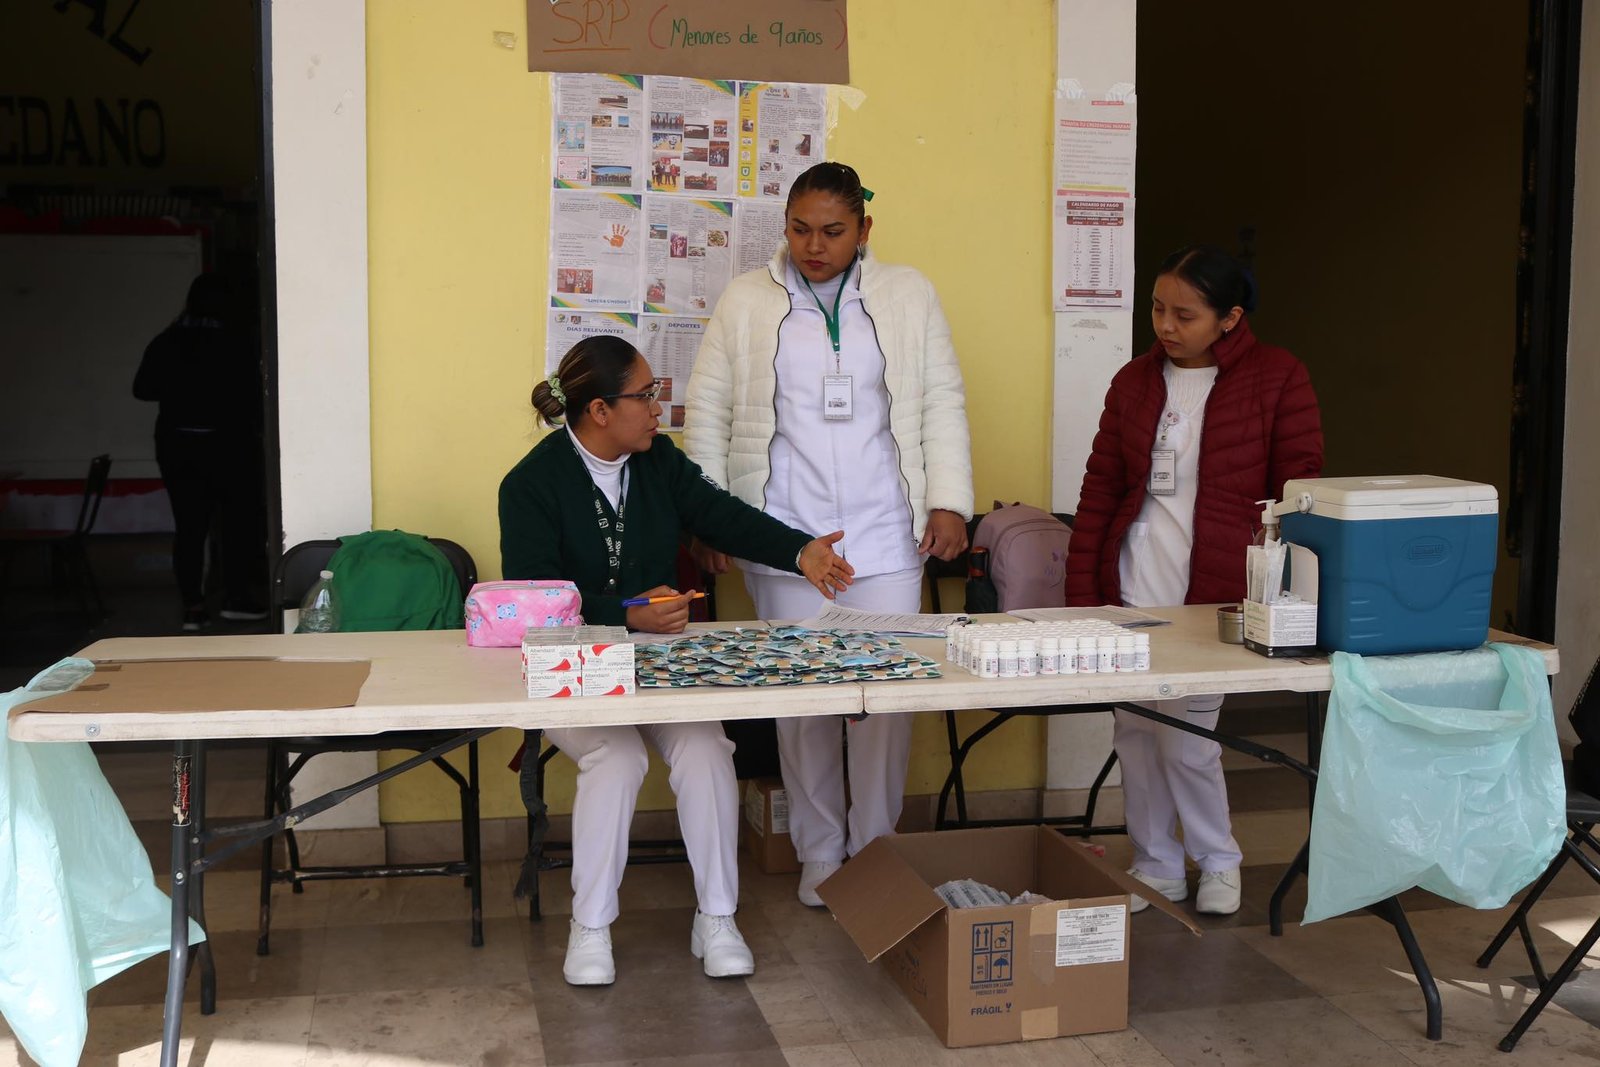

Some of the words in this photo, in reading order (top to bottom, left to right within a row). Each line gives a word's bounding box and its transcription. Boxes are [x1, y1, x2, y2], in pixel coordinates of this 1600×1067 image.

[551, 0, 630, 46] SRP
[739, 24, 759, 44] de
[970, 1005, 1003, 1016] FRÁGIL
